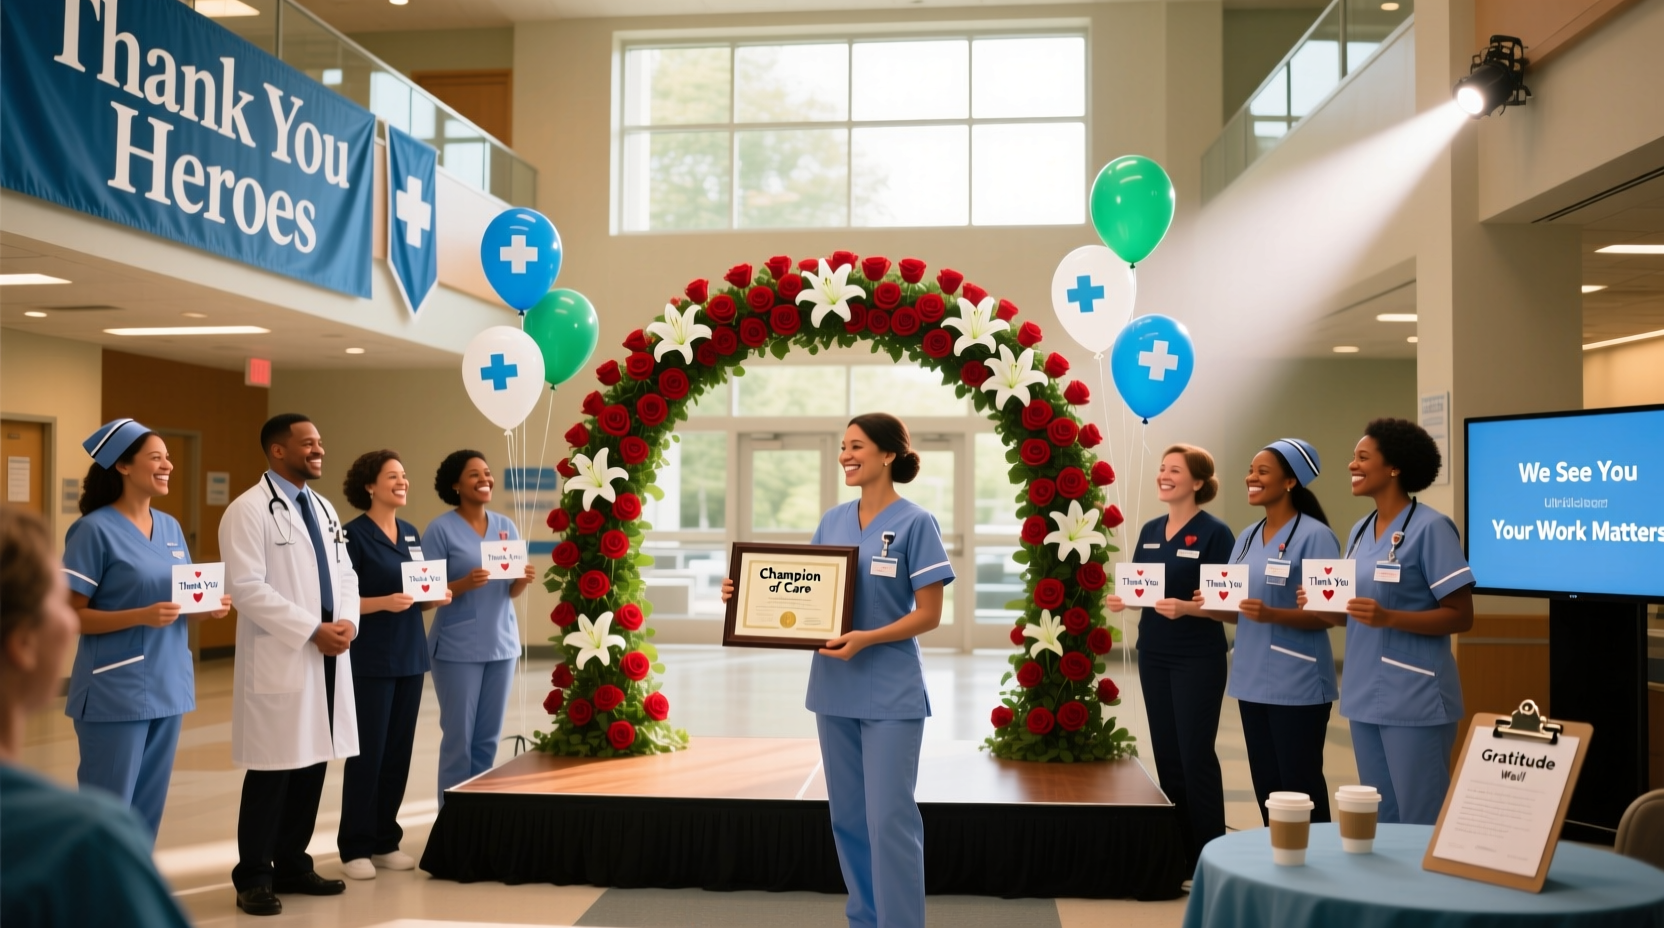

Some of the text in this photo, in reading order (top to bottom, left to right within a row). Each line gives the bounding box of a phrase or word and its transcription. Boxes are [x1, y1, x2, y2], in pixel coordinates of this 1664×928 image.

[53, 0, 350, 188] Thank You
[107, 101, 317, 253] Heroes
[1518, 460, 1638, 483] We See You
[1492, 519, 1664, 542] Your Work Matters
[759, 567, 821, 582] Champion
[769, 581, 812, 593] of Care
[1481, 748, 1556, 771] Gratitude
